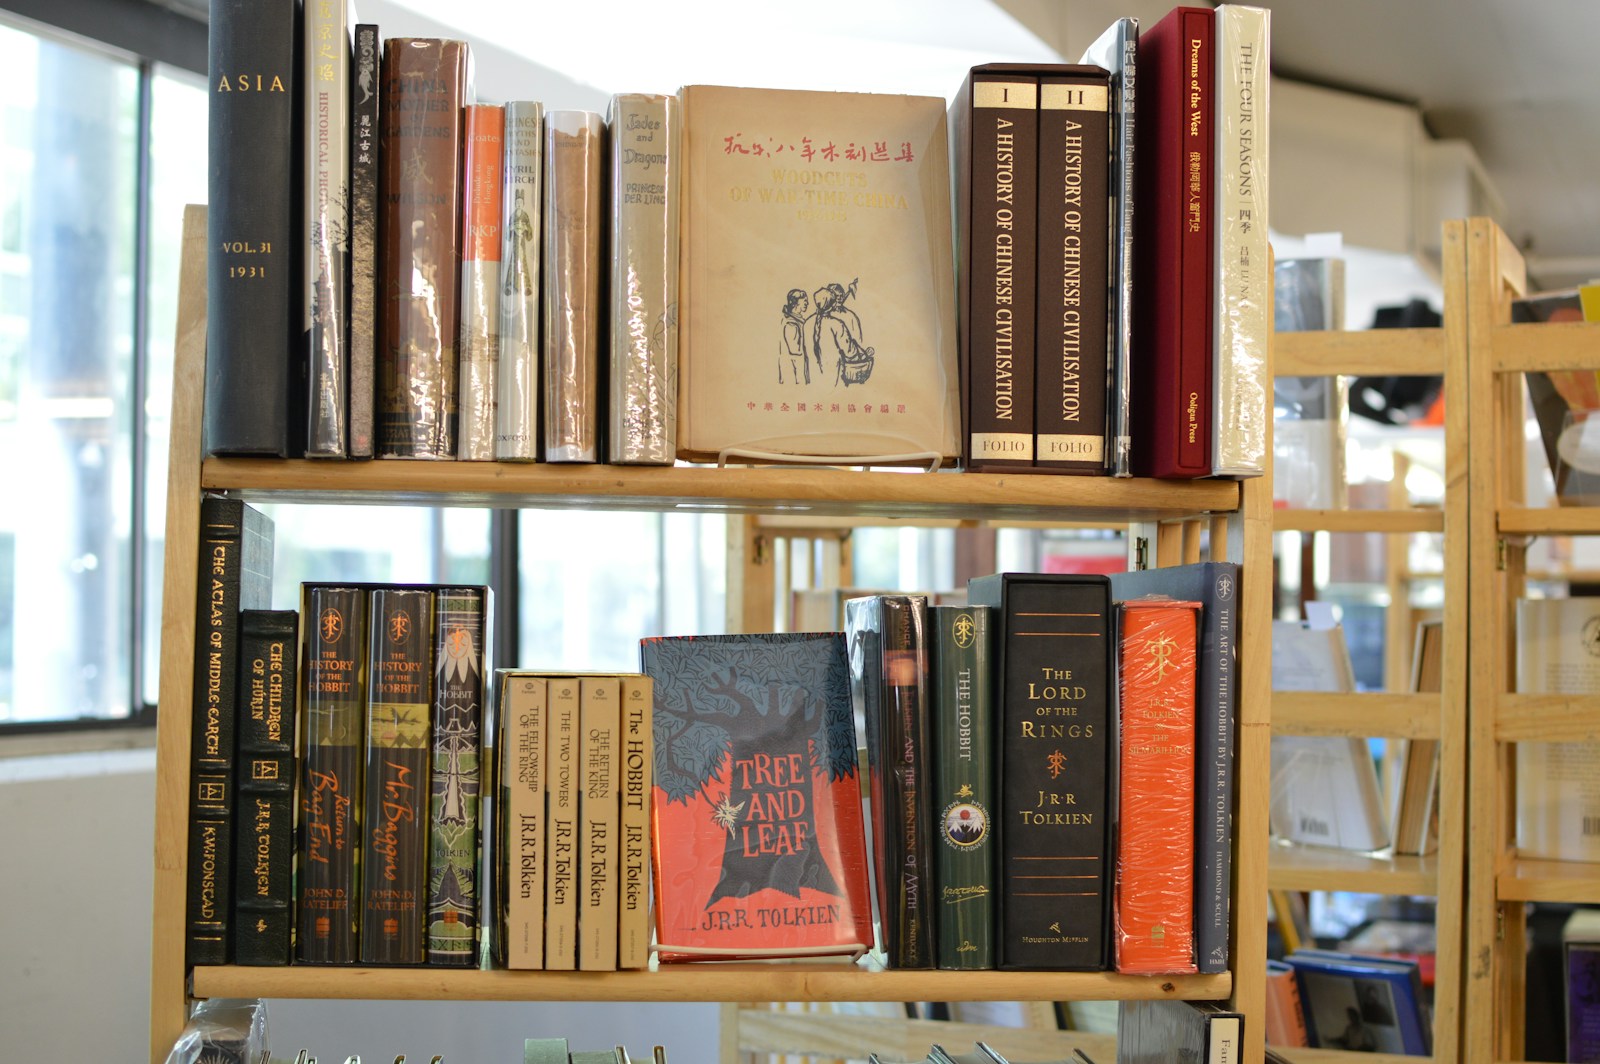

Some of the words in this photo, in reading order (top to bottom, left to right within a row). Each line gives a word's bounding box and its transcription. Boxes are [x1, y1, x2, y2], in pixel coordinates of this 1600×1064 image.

[1191, 38, 1202, 80] Dreams
[1240, 43, 1252, 74] THE
[217, 74, 285, 93] ASIA
[386, 79, 449, 95] CHINA
[1191, 80, 1202, 93] of
[1002, 88, 1008, 103] I
[1067, 90, 1083, 105] II
[1190, 92, 1202, 109] the
[1239, 80, 1252, 124] FOUR
[318, 91, 329, 168] HISTORICAL
[385, 126, 450, 138] GARDENS
[626, 113, 661, 131] Jades
[996, 117, 1014, 130] A
[1065, 119, 1083, 131] A
[1124, 118, 1135, 142] Hair
[1190, 111, 1202, 137] West
[636, 132, 654, 143] and
[996, 133, 1014, 206] HISTORY
[1064, 135, 1083, 207] HISTORY
[1124, 144, 1135, 191] Fashions
[1239, 128, 1252, 196] SEASONS
[473, 174, 481, 204] Prelude
[483, 164, 495, 204] Hongkong
[771, 167, 868, 188] WOODCUTS
[624, 194, 642, 205] DER
[729, 185, 753, 202] OF
[853, 192, 909, 210] CHINA
[1124, 194, 1134, 207] of
[469, 225, 497, 237] RKP
[996, 208, 1014, 231] OF
[1064, 210, 1082, 233] OF
[223, 242, 257, 254] VOL.
[259, 242, 272, 254] 31
[229, 266, 266, 278] 1931
[995, 233, 1013, 305] CHINESE
[1063, 235, 1082, 307] CHINESE
[995, 308, 1013, 421] CIVILISATION
[1062, 310, 1080, 422] CIVILISATION
[1188, 392, 1199, 422] Ooligan
[1187, 423, 1198, 444] Press
[983, 440, 1025, 452] FOLIO
[1050, 441, 1093, 454] FOLIO
[212, 546, 226, 576] THE
[210, 579, 224, 627] ATLAS
[1219, 608, 1229, 632] THE
[210, 631, 222, 650] OF
[1219, 633, 1229, 656] ART
[270, 642, 284, 671] THE
[308, 660, 354, 672] HISTORY
[322, 651, 338, 659] THE
[374, 661, 423, 672] HISTORY
[390, 652, 407, 660] THE
[1219, 657, 1228, 673] OF
[252, 658, 264, 678] OF
[325, 673, 342, 681] THE
[384, 674, 395, 682] OF
[395, 674, 412, 682] THE
[1041, 667, 1072, 680] THE
[308, 682, 351, 693] HOBBIT
[376, 682, 420, 694] HOBBIT
[439, 688, 473, 700] HOBBIT
[958, 668, 971, 701] THE
[1028, 683, 1087, 700] LORD
[1218, 675, 1228, 700] THE
[267, 672, 283, 741] CHILDREN
[529, 705, 539, 727] THE
[1035, 706, 1052, 716] OF
[1054, 706, 1078, 716] THE
[519, 714, 529, 729] OF
[560, 710, 571, 732] THE
[629, 709, 643, 735] The
[959, 704, 972, 761] HOBBIT
[1020, 720, 1094, 738] RINGS
[1218, 700, 1227, 742] HOBBIT
[519, 731, 529, 753] THE
[589, 728, 600, 743] OF
[600, 728, 610, 751] THE
[1151, 734, 1170, 742] THE
[559, 735, 571, 762] TWO
[589, 746, 599, 767] THE
[904, 735, 915, 763] AND
[1217, 743, 1227, 758] BY
[518, 756, 528, 783] RING
[528, 730, 539, 793] FELLOWSHIP
[735, 752, 805, 790] TREE
[588, 770, 599, 800] KING
[599, 754, 610, 799] RETURN
[627, 740, 644, 811] HOBBIT
[905, 765, 916, 787] THE
[1215, 758, 1226, 790] J.R.R.
[558, 764, 570, 808] TOWERS
[334, 793, 351, 836] Return
[745, 789, 806, 823] AND
[1019, 810, 1093, 825] TOLKIEN
[1215, 793, 1226, 843] TOLKIEN
[335, 838, 345, 850] to
[371, 800, 414, 882] Baggins
[742, 821, 809, 858] LEAF
[255, 834, 271, 897] TOLKIEN
[904, 853, 917, 869] OF
[520, 851, 537, 899] Tolkien
[554, 857, 571, 905] Tolkien
[590, 858, 607, 908] Tolkien
[1215, 851, 1223, 895] HAMMOND
[303, 888, 333, 899] JOHN
[335, 888, 347, 898] D.
[371, 889, 400, 899] JOHN
[626, 862, 642, 911] Tolkien
[904, 872, 920, 910] MYTH
[702, 908, 754, 932] J.R.R.
[757, 904, 841, 928] TOLKIEN
[1214, 901, 1222, 928] SCULL
[1022, 936, 1060, 944] HOUGHTON
[1209, 958, 1225, 966] HMH
